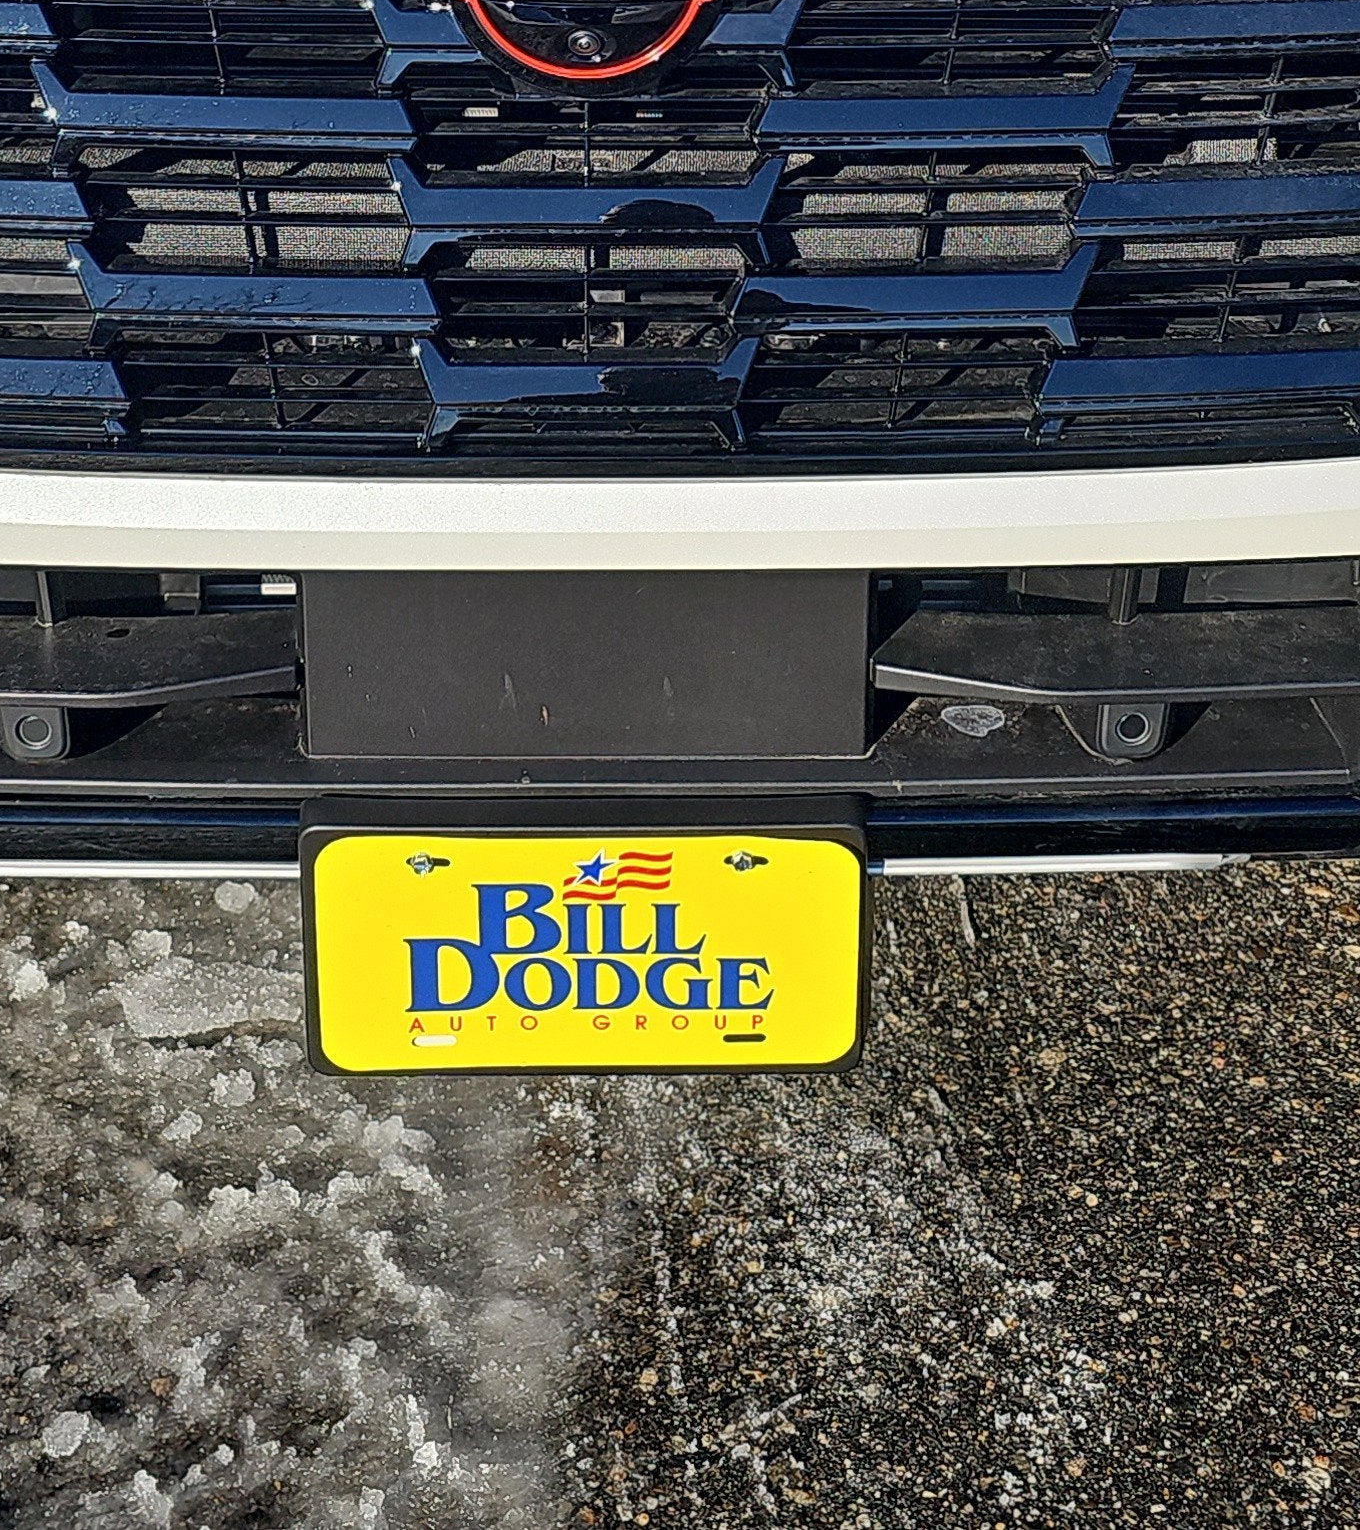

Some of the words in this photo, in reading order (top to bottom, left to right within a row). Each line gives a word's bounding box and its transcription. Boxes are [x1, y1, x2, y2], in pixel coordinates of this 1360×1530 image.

[471, 883, 707, 955] BILL
[403, 938, 775, 1011] DODGE
[408, 1015, 539, 1033] AUTO
[593, 1014, 763, 1031] GROUP
